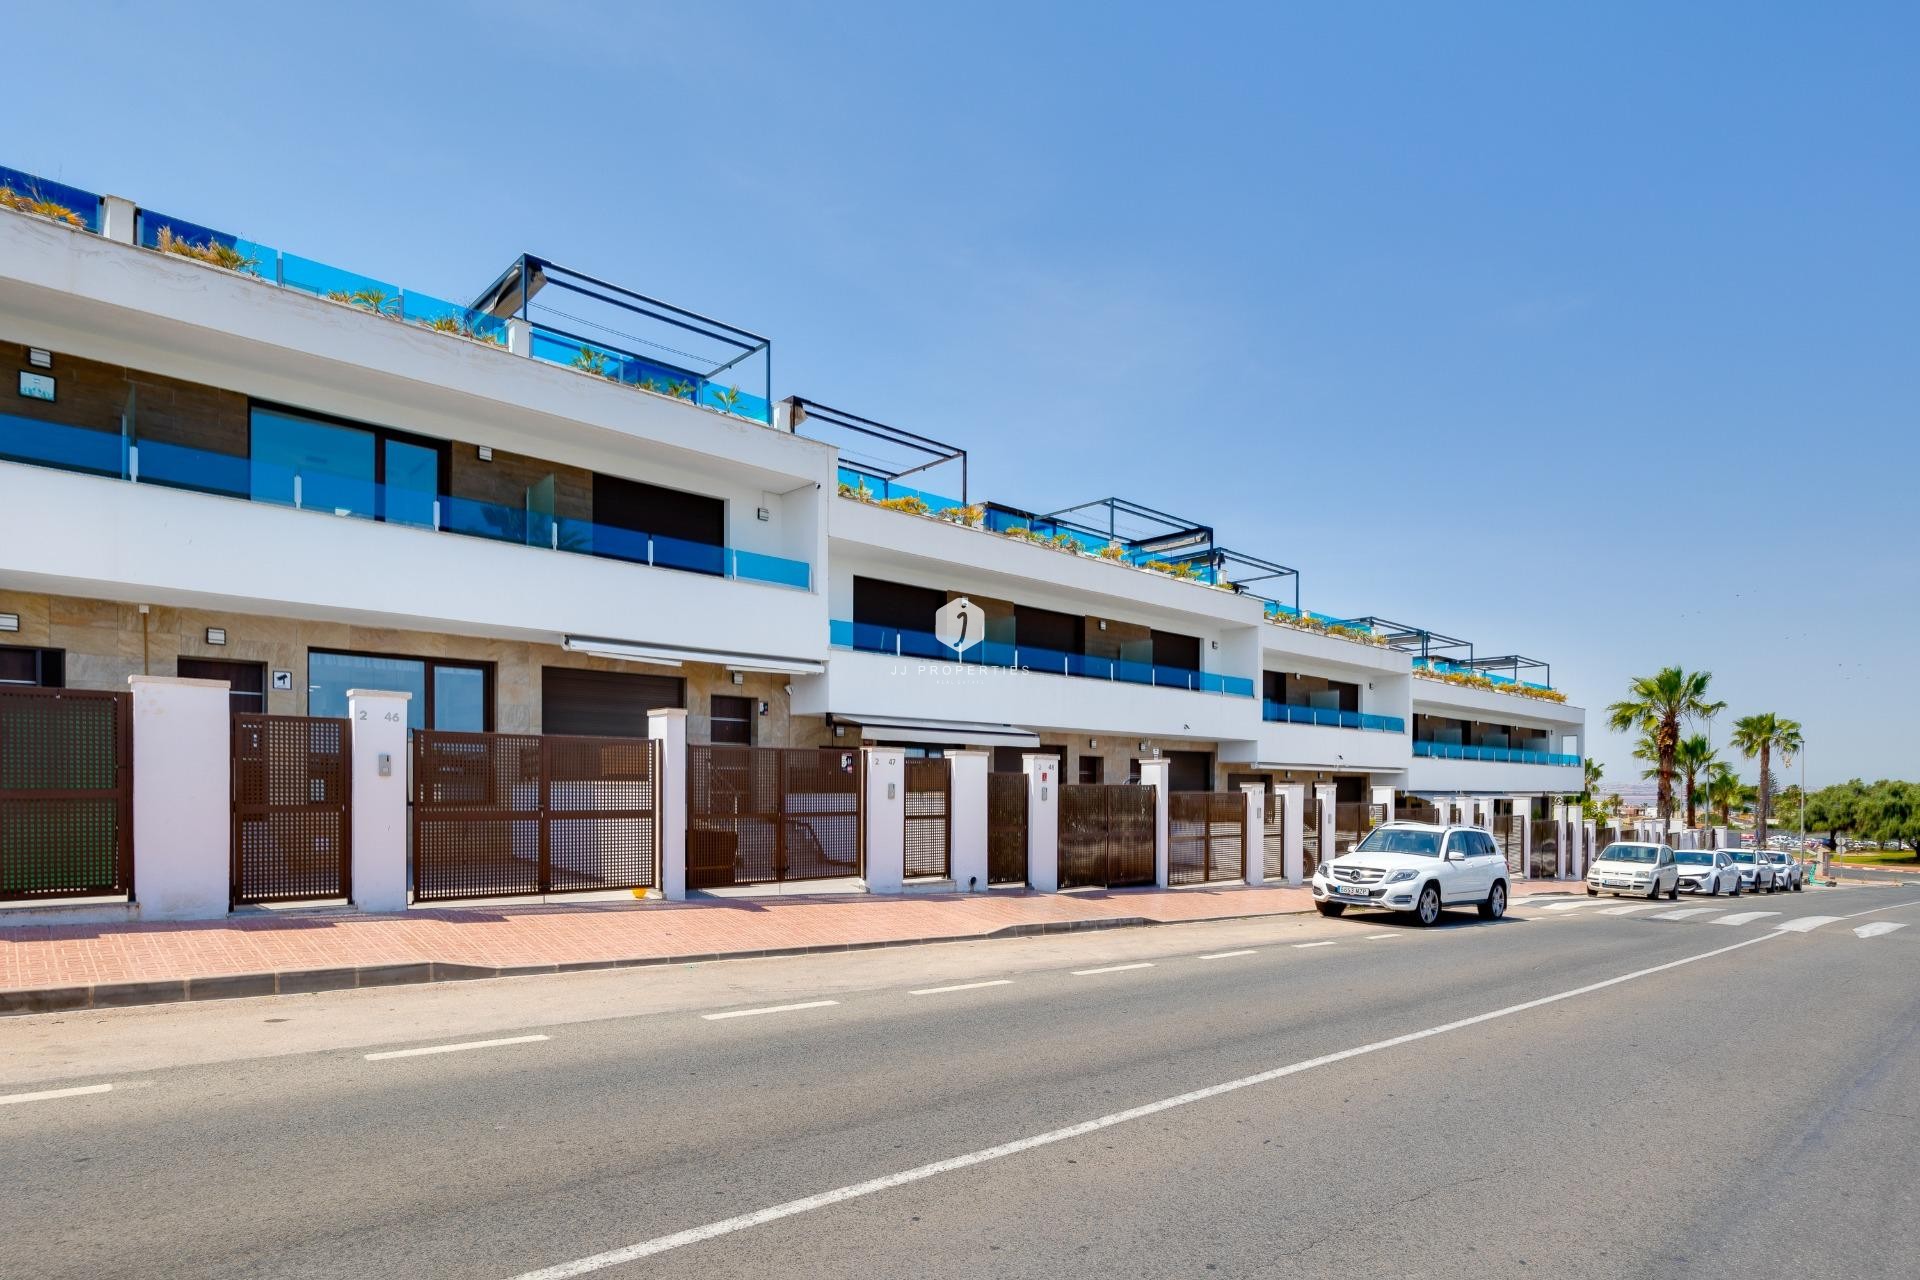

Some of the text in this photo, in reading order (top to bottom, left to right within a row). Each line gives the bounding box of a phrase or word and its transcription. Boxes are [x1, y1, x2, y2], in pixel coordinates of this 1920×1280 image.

[359, 710, 400, 722] 2 46
[888, 758, 896, 766] 47
